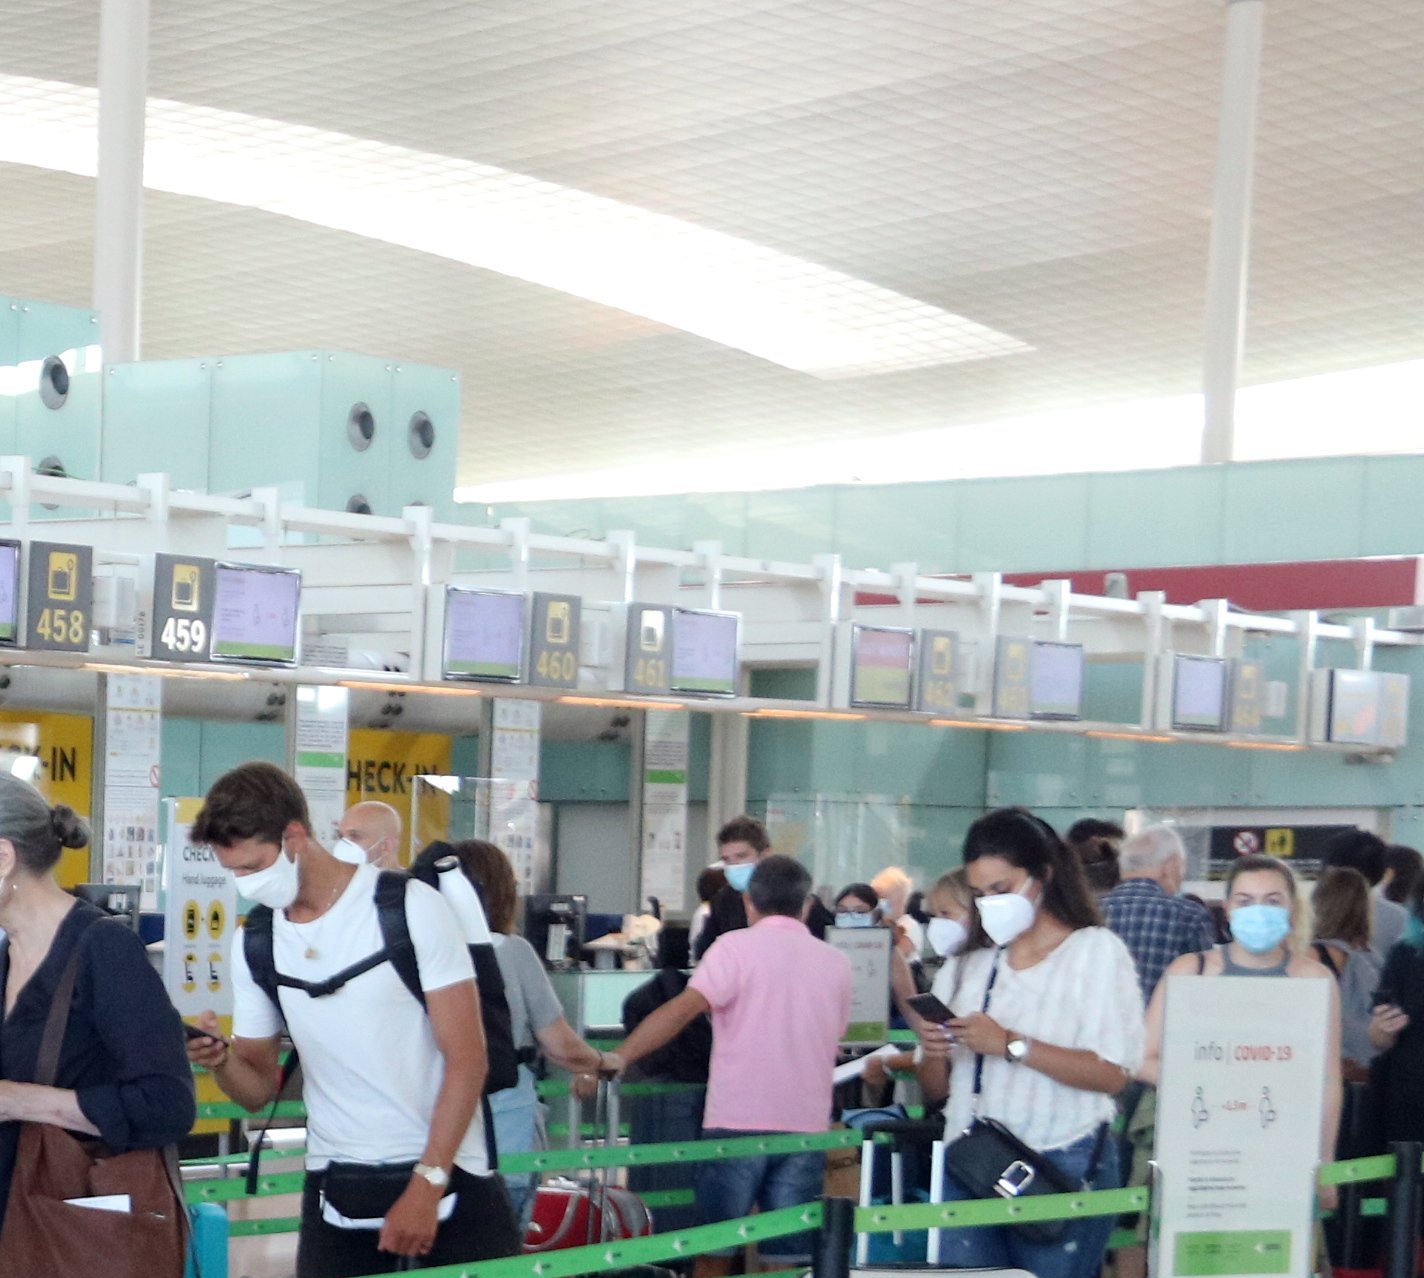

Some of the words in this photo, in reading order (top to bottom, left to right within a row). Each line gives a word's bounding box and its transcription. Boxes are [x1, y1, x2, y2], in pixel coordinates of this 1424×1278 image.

[36, 607, 85, 644] 458
[160, 616, 207, 654] 459
[536, 650, 577, 681] 460
[633, 658, 667, 689] 461
[182, 846, 216, 862] CHECK
[1194, 1040, 1224, 1061] info
[1233, 1044, 1294, 1062] COVID-19
